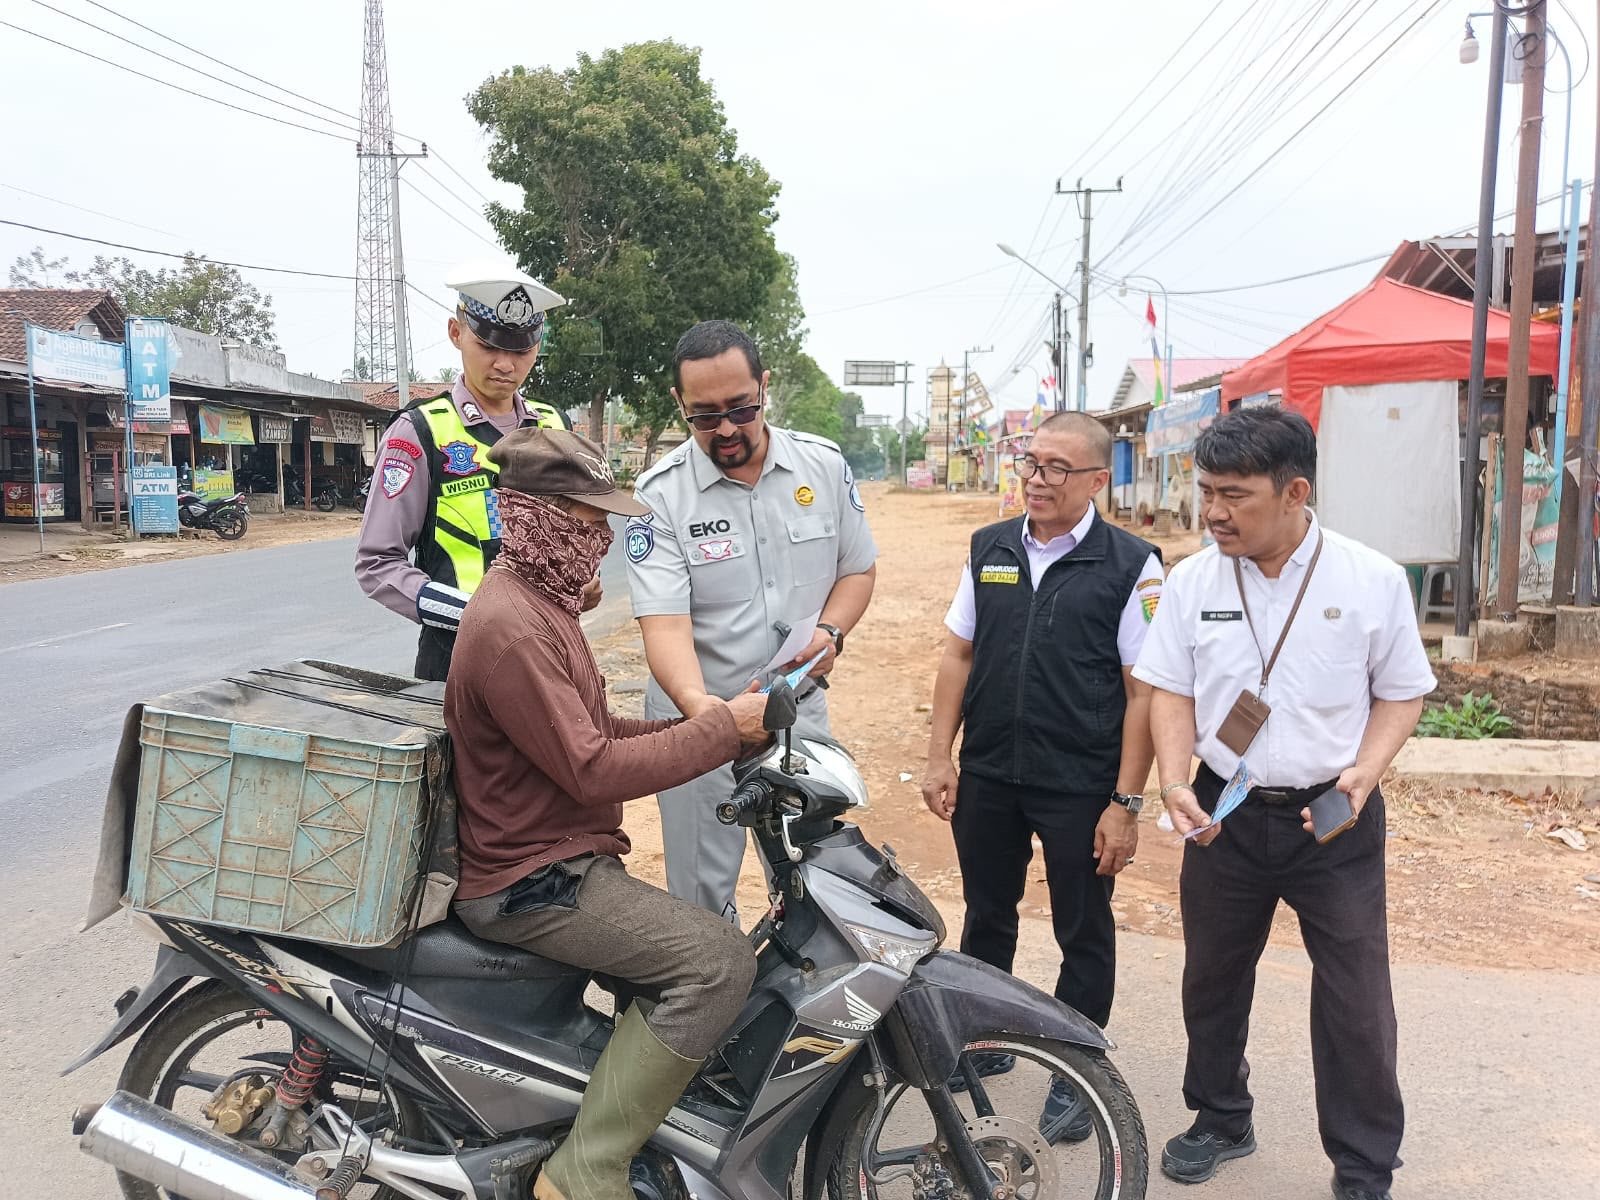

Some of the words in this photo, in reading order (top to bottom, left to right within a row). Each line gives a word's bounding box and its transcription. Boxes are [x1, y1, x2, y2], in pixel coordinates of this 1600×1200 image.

[141, 484, 169, 493] ATM
[446, 477, 486, 494] WISNU
[689, 519, 731, 538] EKO
[831, 1018, 875, 1031] HONDA
